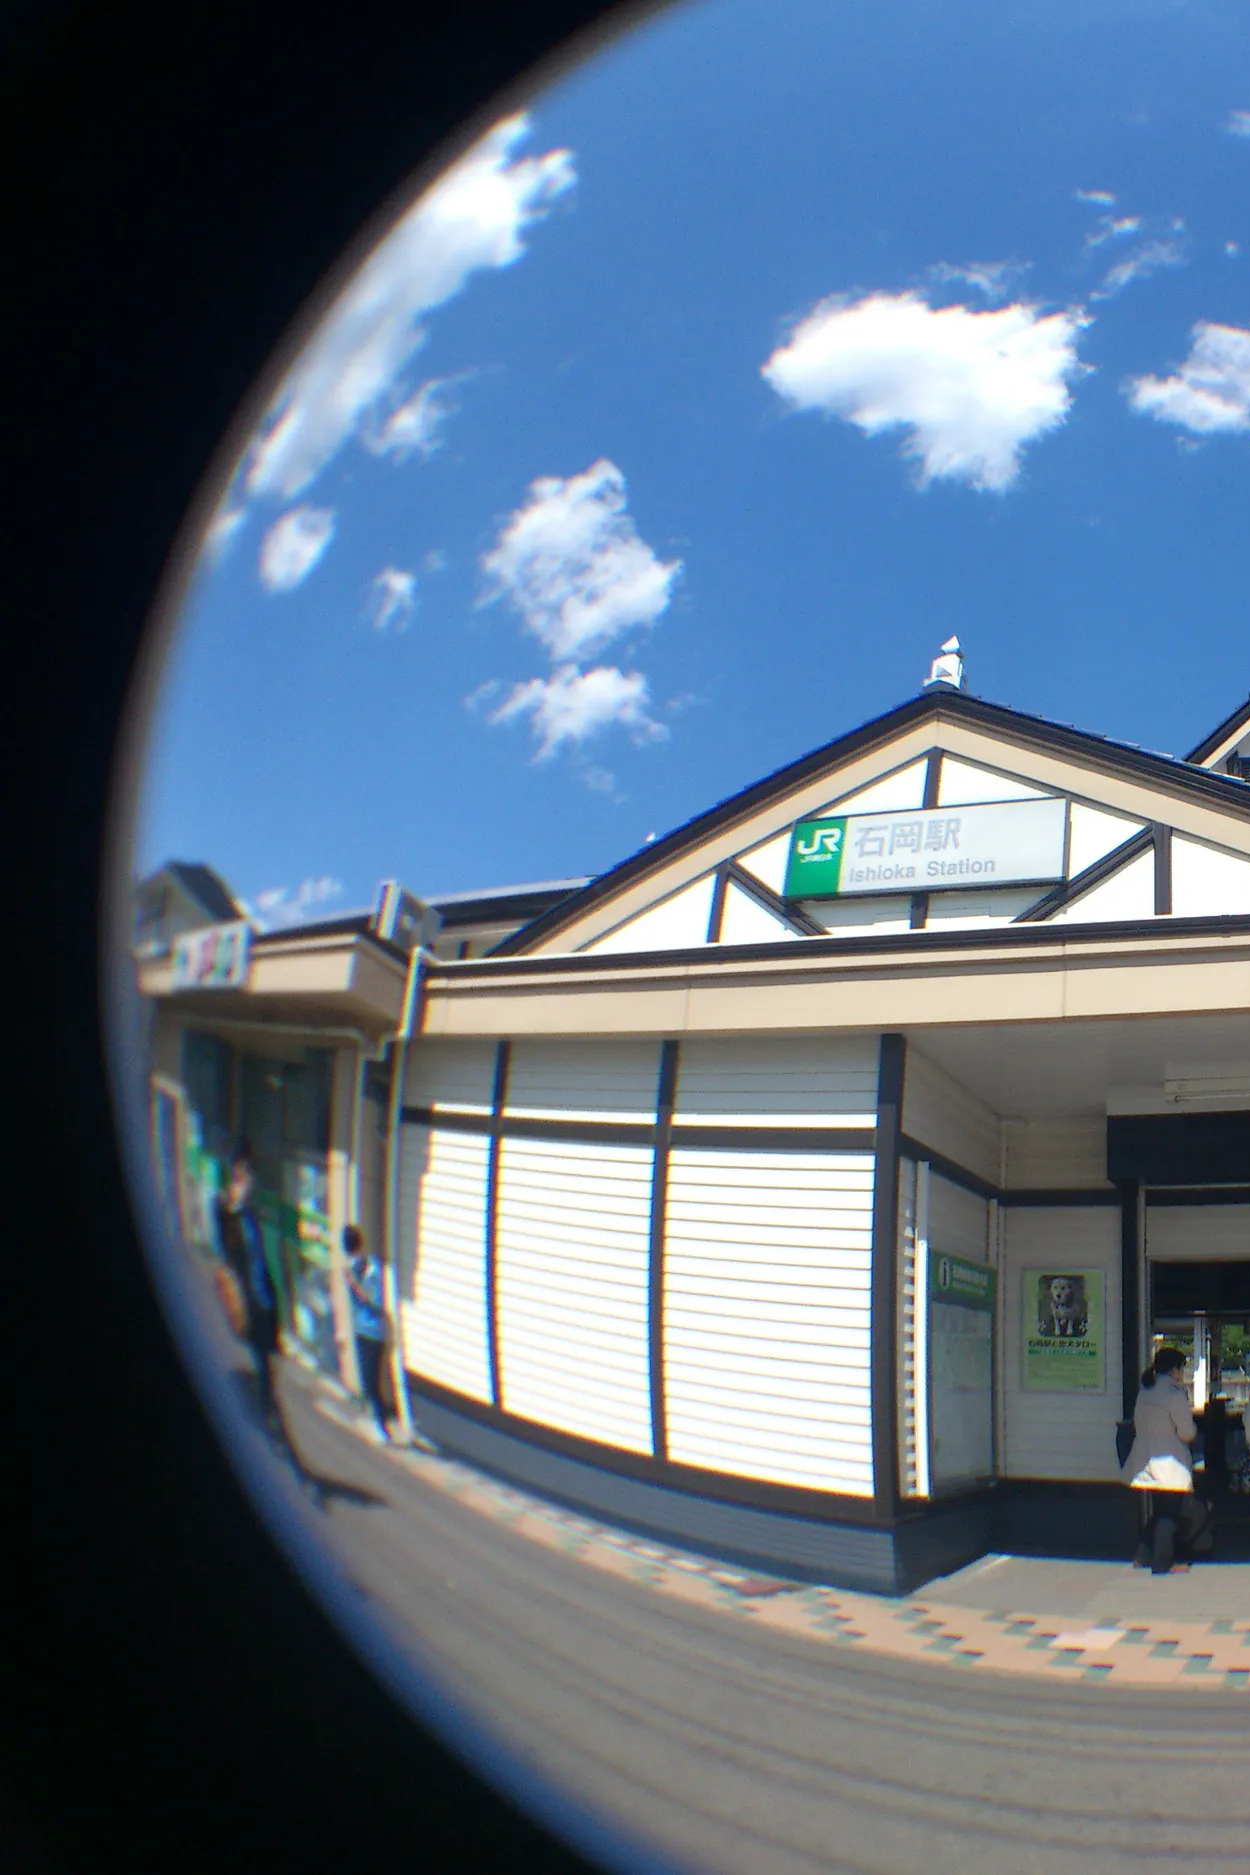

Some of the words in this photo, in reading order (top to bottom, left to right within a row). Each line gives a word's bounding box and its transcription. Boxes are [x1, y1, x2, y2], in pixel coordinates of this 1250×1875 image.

[796, 828, 842, 855] JR
[854, 818, 962, 858] 石岡駅
[850, 863, 916, 883] Ishioka
[926, 858, 996, 878] Station
